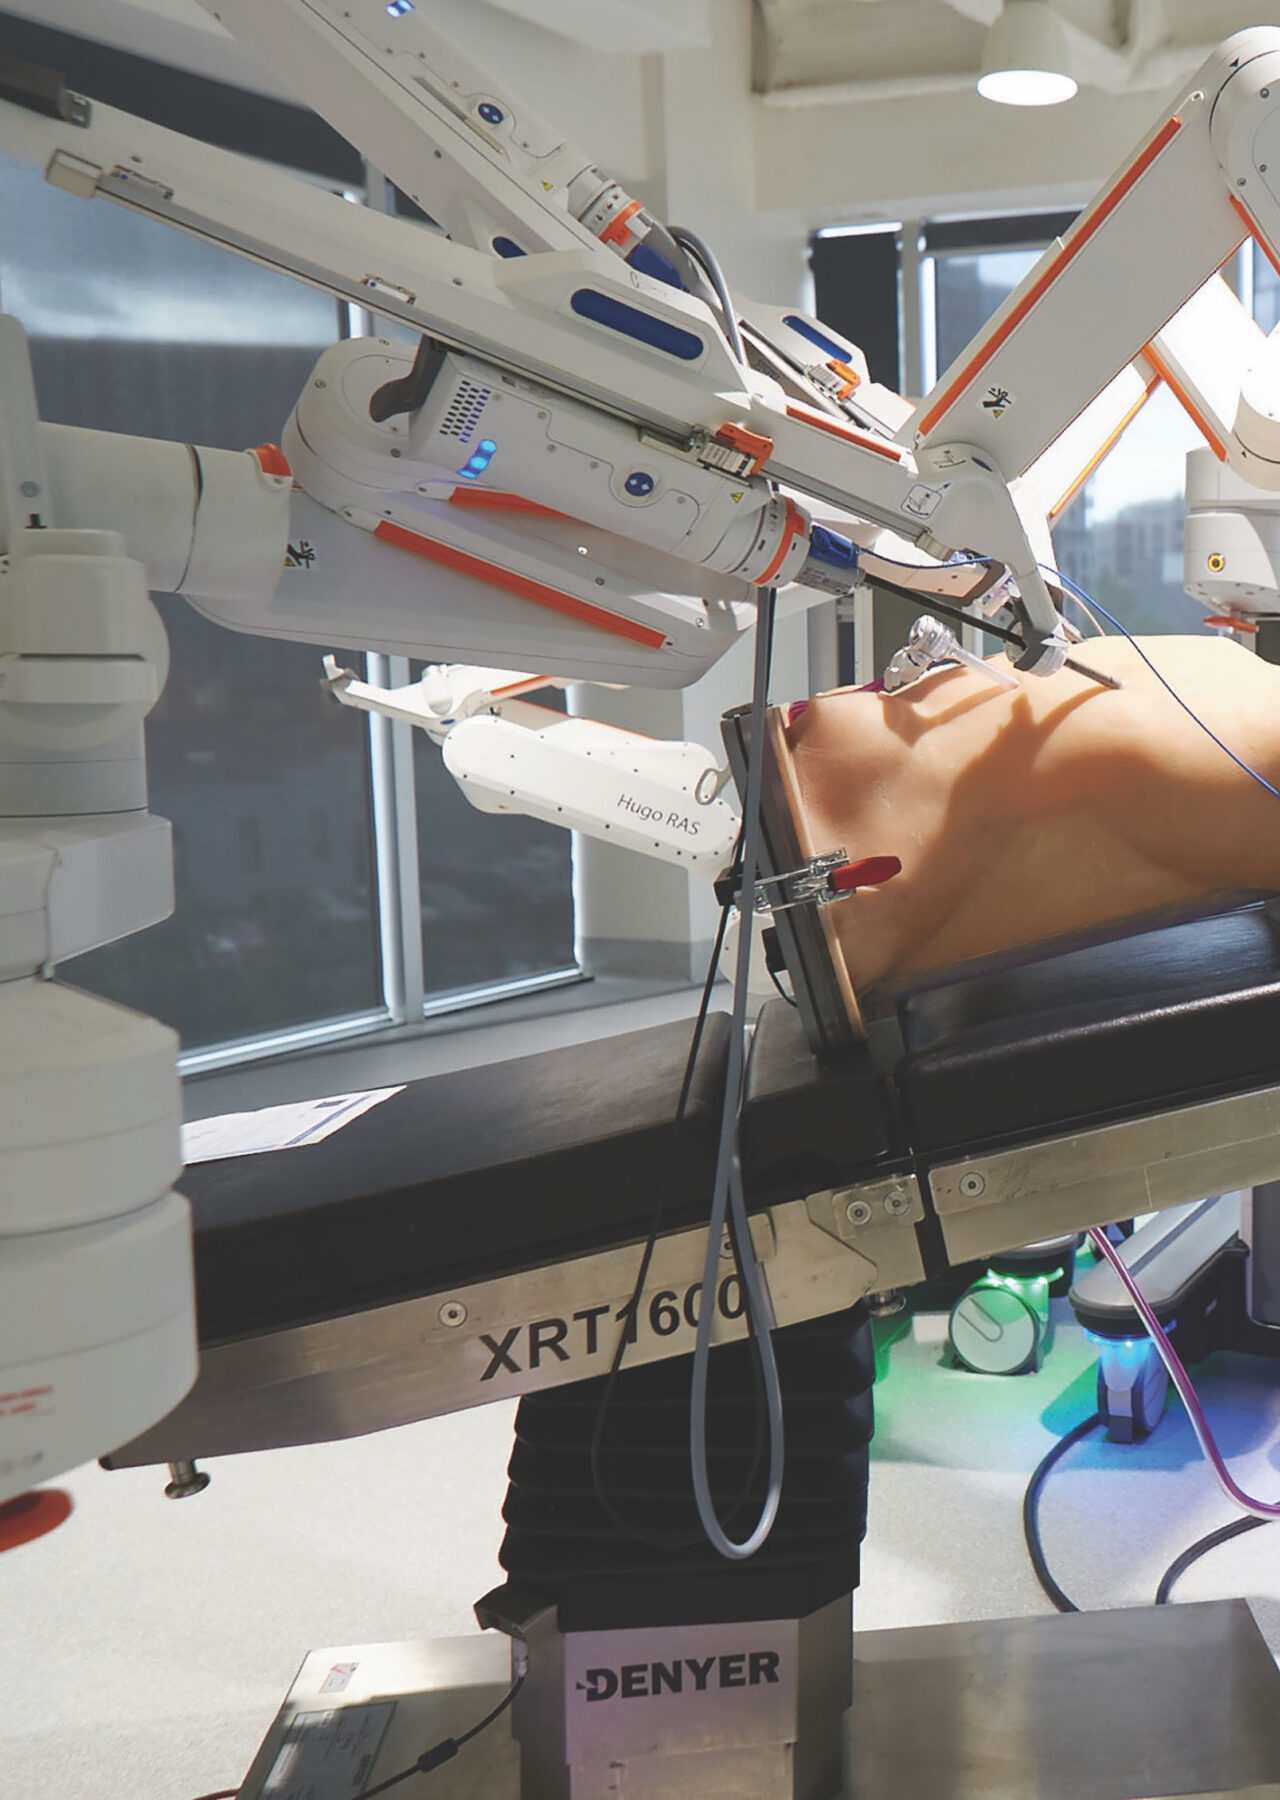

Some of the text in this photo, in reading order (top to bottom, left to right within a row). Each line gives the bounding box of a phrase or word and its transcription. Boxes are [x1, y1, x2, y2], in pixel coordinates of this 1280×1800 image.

[617, 793, 701, 835] Hugo RAS
[576, 1651, 780, 1702] DENYER
